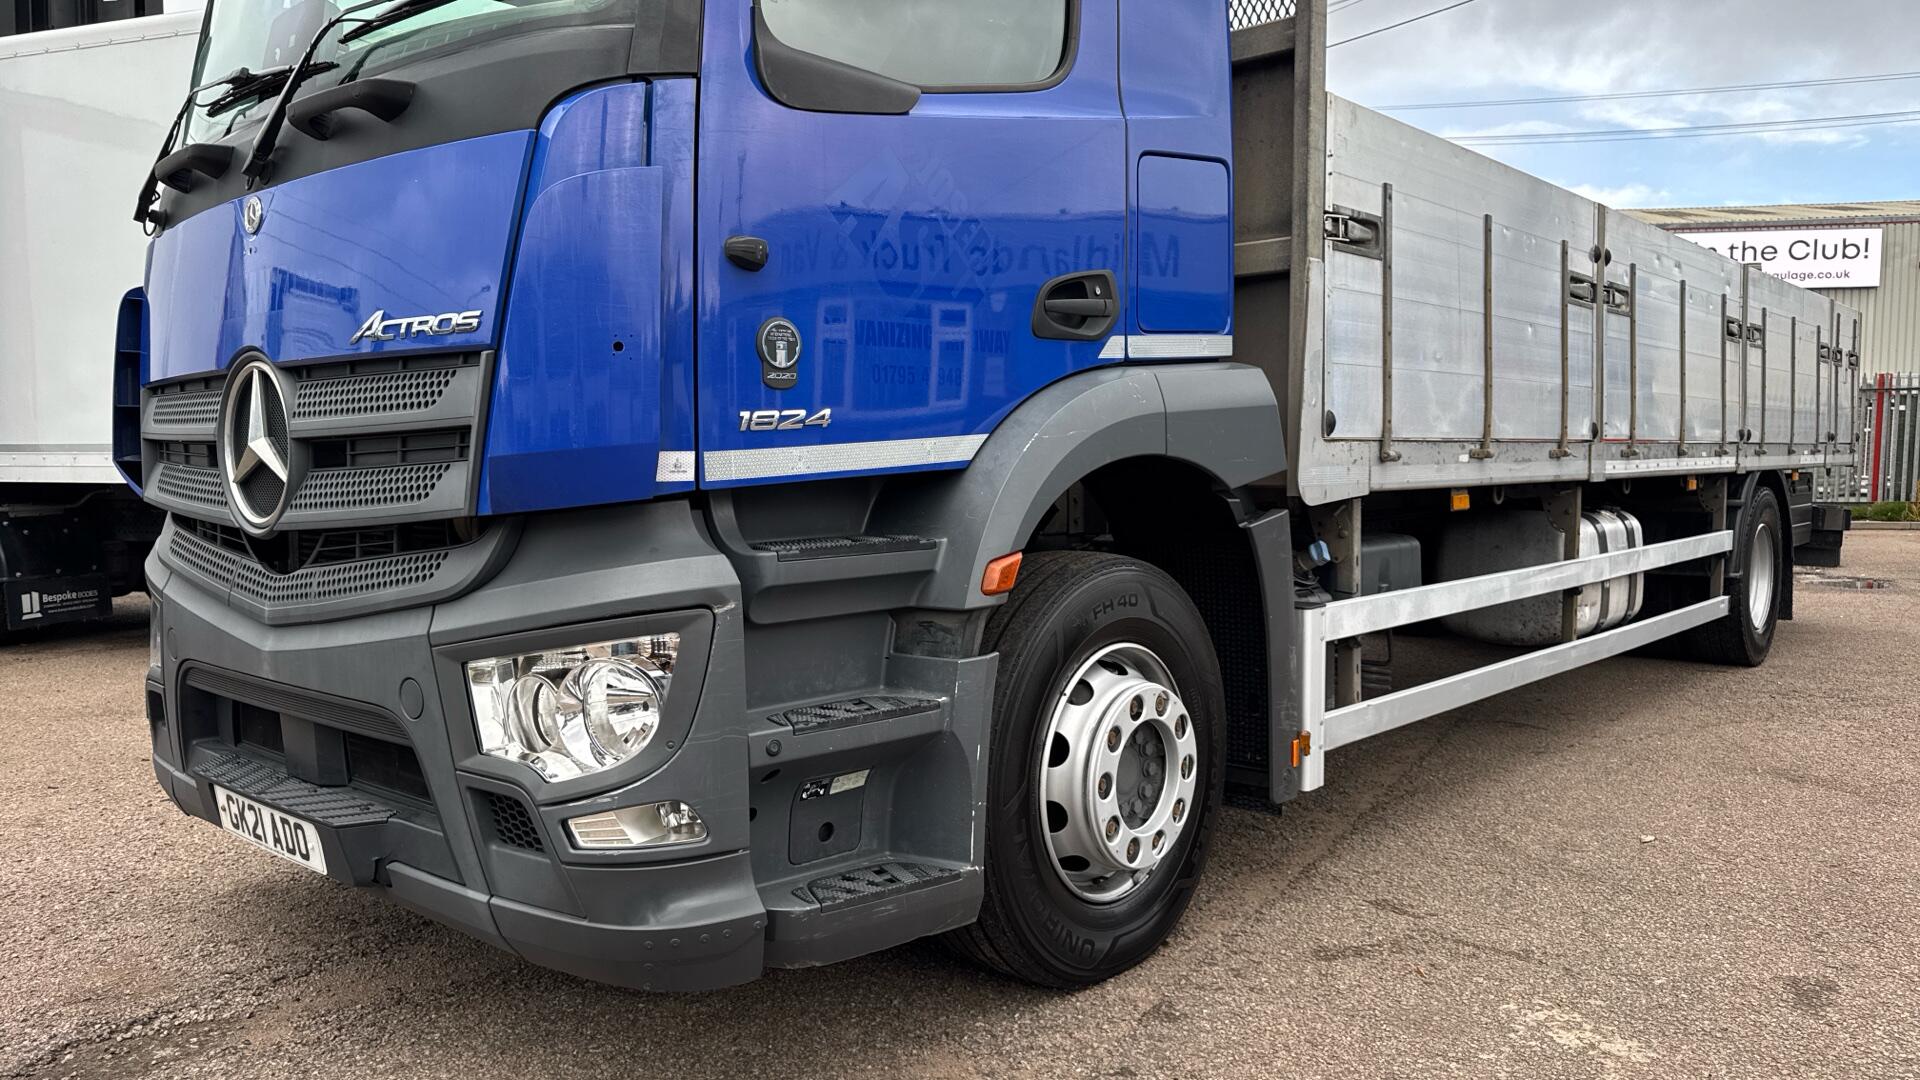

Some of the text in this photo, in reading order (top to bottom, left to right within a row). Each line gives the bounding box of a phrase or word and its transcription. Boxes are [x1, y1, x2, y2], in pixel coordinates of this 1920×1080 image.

[1728, 240, 1778, 262] the
[1788, 238, 1870, 261] Club!
[1764, 269, 1850, 282] aulage.co.uk
[350, 309, 482, 345] ACTROS
[767, 372, 797, 380] 2020
[739, 408, 832, 431] 1824
[42, 590, 77, 603] Bespoke
[1092, 592, 1139, 621] FH 40
[226, 794, 310, 861] GK21 ADO
